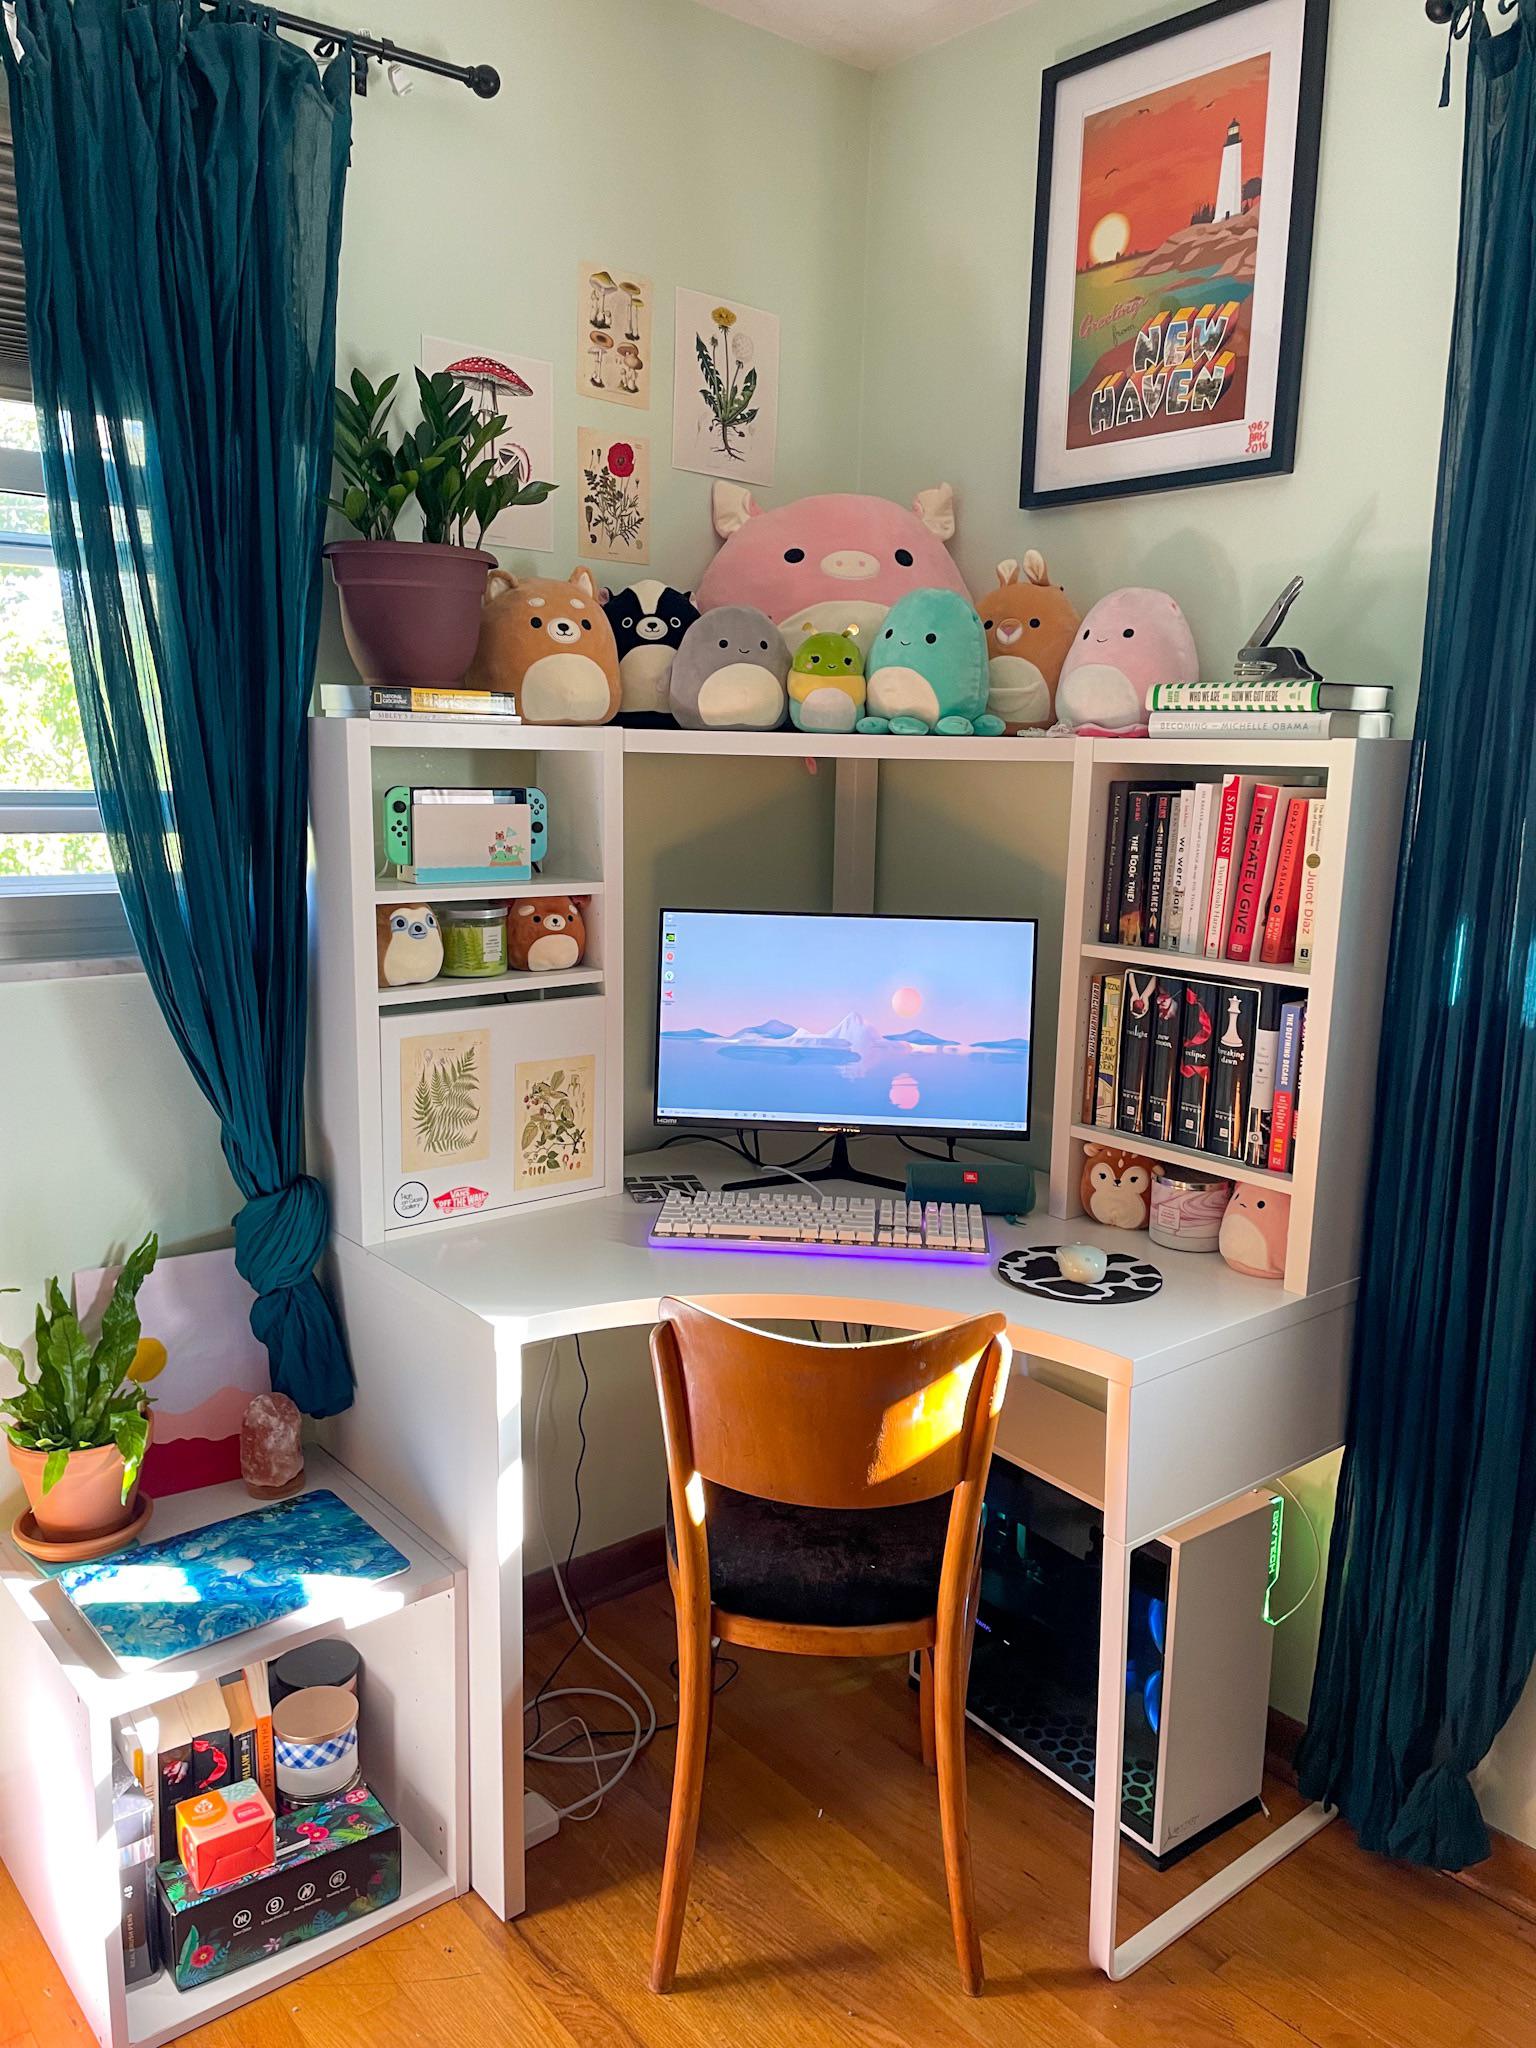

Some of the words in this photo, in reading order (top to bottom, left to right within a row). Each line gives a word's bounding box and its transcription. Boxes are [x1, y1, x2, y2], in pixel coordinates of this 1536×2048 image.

[1132, 306, 1235, 373] NEW
[1089, 358, 1230, 436] HAVEN
[1248, 420, 1270, 432] 1967
[1245, 441, 1269, 454] 2016
[1189, 691, 1201, 702] WHO
[1202, 691, 1210, 702] WE
[1210, 691, 1221, 702] ARE
[1231, 690, 1245, 702] HOW
[1245, 690, 1253, 702] WE
[1253, 690, 1265, 702] GOT
[1265, 690, 1279, 702] HERE
[1160, 721, 1207, 730] BECOMING
[1221, 721, 1267, 730] MICHELLE
[1271, 722, 1309, 731] OBAMA
[1221, 795, 1236, 854] SAPIENS
[1252, 807, 1268, 836] THE
[1288, 803, 1300, 836] CRAZY
[1130, 834, 1139, 854] THE
[1178, 836, 1186, 853] we
[1283, 838, 1293, 863] RICH
[1152, 845, 1163, 883] HUNGER
[1245, 839, 1261, 880] HATE
[1175, 856, 1184, 887] were
[1276, 865, 1288, 901] ASIANS
[1149, 883, 1159, 914] GAMES
[1213, 888, 1224, 909] Noah
[1242, 883, 1254, 894] U
[1305, 871, 1317, 905] Junot
[1172, 886, 1185, 916] liars
[1235, 899, 1251, 935] GIVE
[1302, 908, 1314, 935] Díaz
[1286, 1013, 1295, 1026] THE
[1127, 1025, 1149, 1039] twilight
[1282, 1027, 1293, 1059] DEFINING
[1155, 1040, 1173, 1049] moon
[1217, 1046, 1245, 1061] breaking
[1184, 1050, 1207, 1063] eclipse
[1220, 1057, 1238, 1066] dawn
[1280, 1059, 1290, 1086] DECADE
[450, 1188, 470, 1199] VANS
[453, 1197, 467, 1207] THE
[261, 1722, 270, 1761] CHASING
[263, 1763, 272, 1788] SPACE
[347, 1791, 366, 1803] 20
[123, 1884, 134, 1899] 48
[270, 1900, 279, 1913] 9
